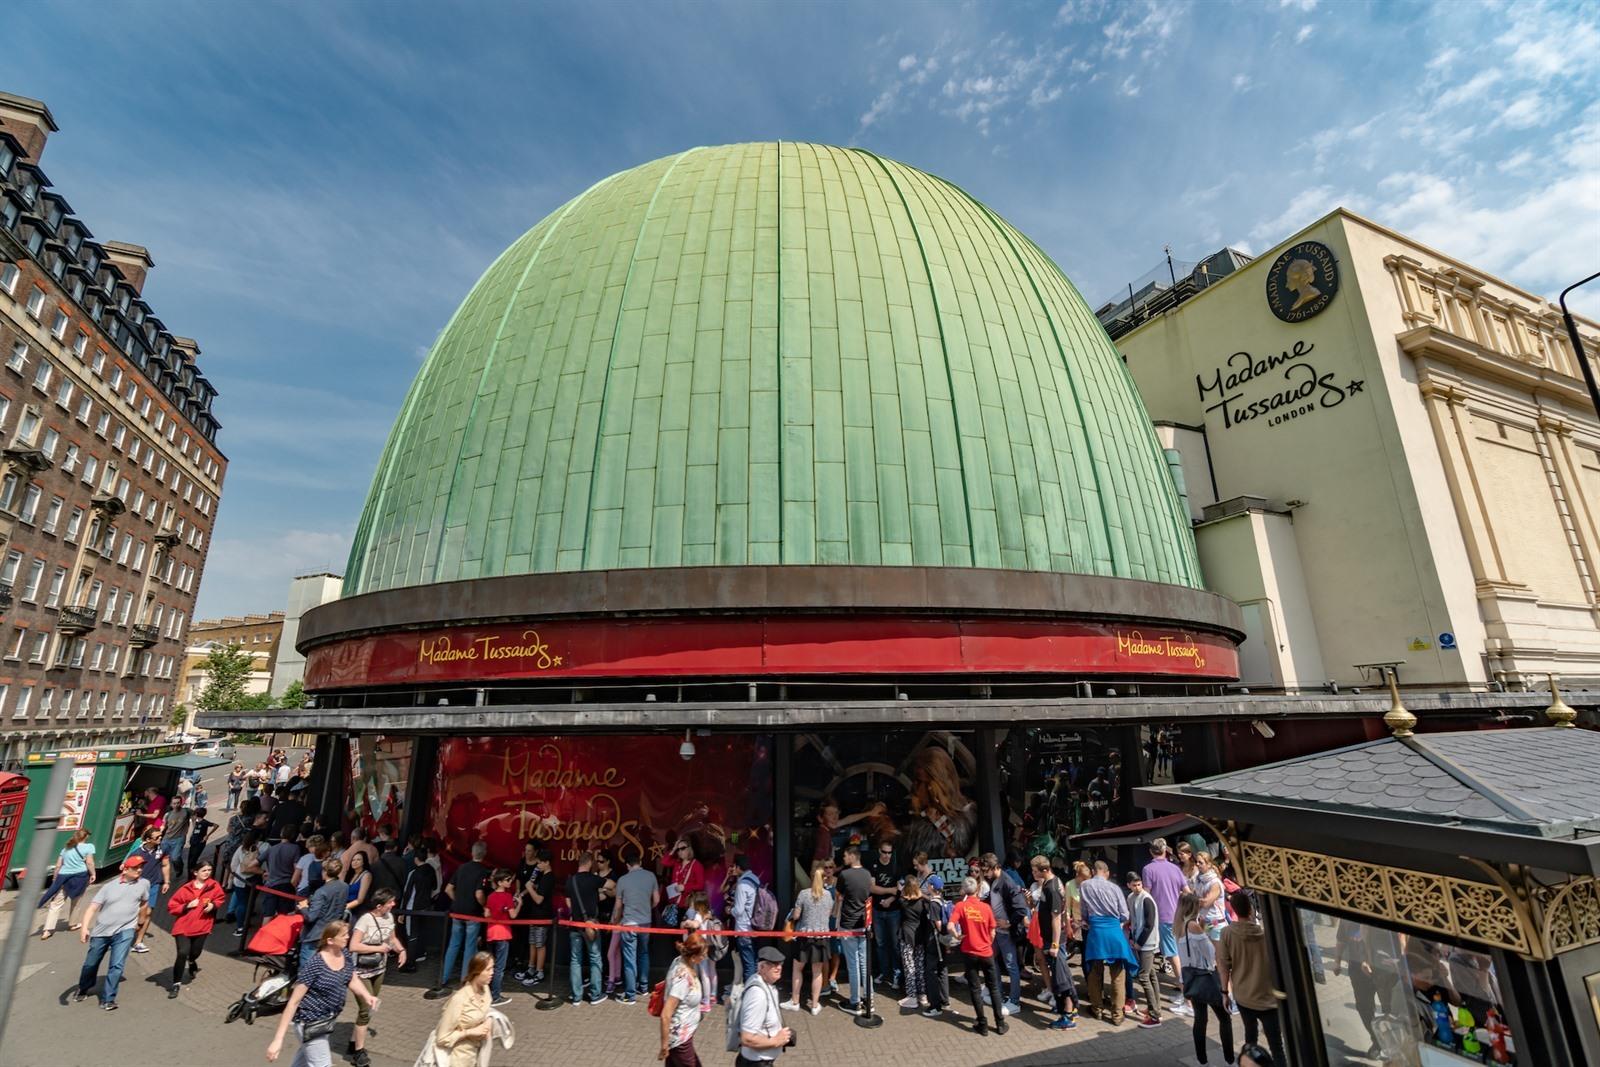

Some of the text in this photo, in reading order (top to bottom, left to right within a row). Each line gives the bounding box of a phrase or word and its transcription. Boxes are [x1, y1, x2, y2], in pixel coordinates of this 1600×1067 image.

[1296, 244, 1334, 281] TUSSAUD
[1196, 340, 1314, 402] Madame
[1205, 363, 1346, 429] Tussauds
[1268, 402, 1315, 427] LONDON
[419, 630, 551, 669] Madame Tussauds
[1117, 630, 1201, 668] Madame Tussauds
[502, 744, 626, 793] Madame
[503, 793, 644, 866] Tussauds
